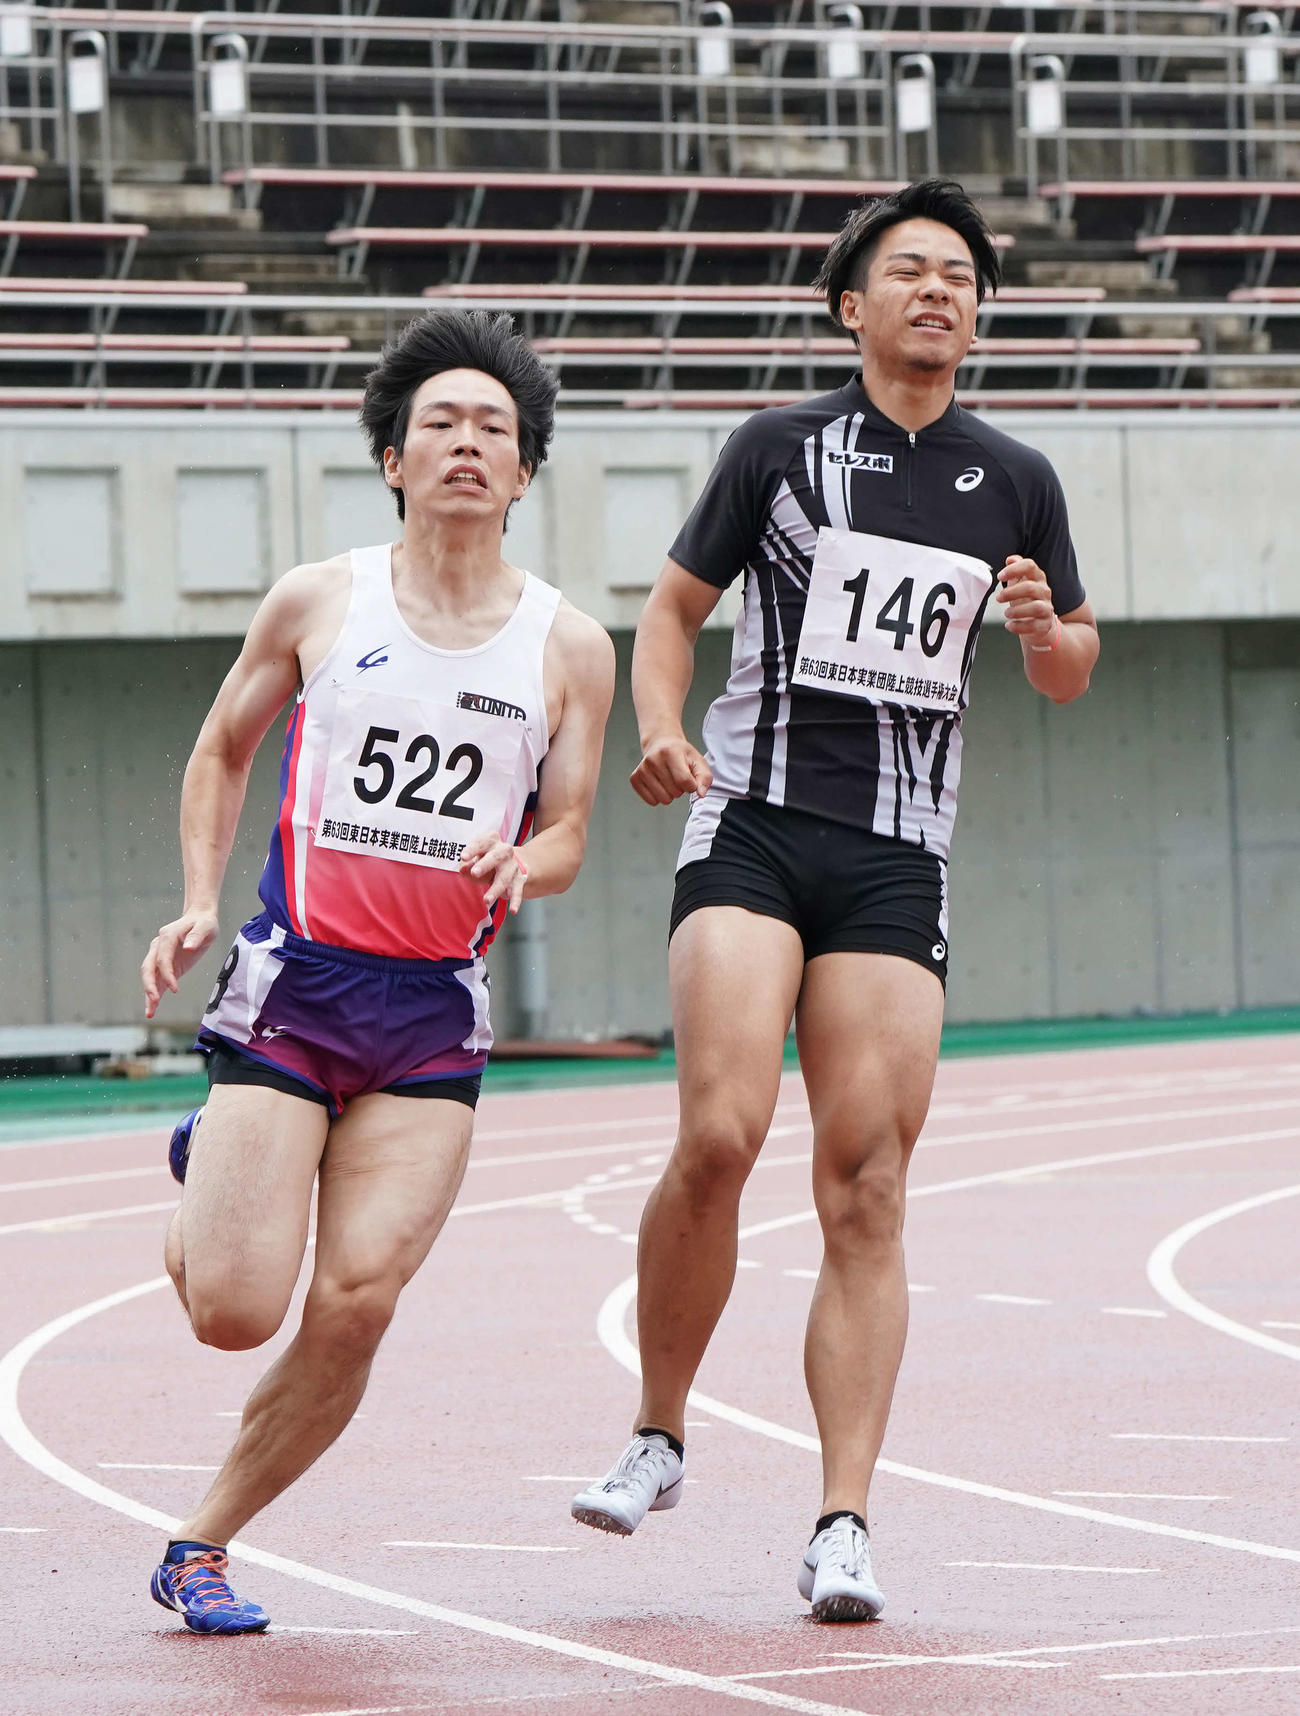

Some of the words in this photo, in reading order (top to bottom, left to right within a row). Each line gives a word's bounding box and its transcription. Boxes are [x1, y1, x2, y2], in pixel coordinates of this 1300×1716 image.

[843, 567, 956, 658] 146
[799, 656, 958, 701] 第63回東日本実業団陸上競技選手権大会
[353, 725, 484, 822] 522
